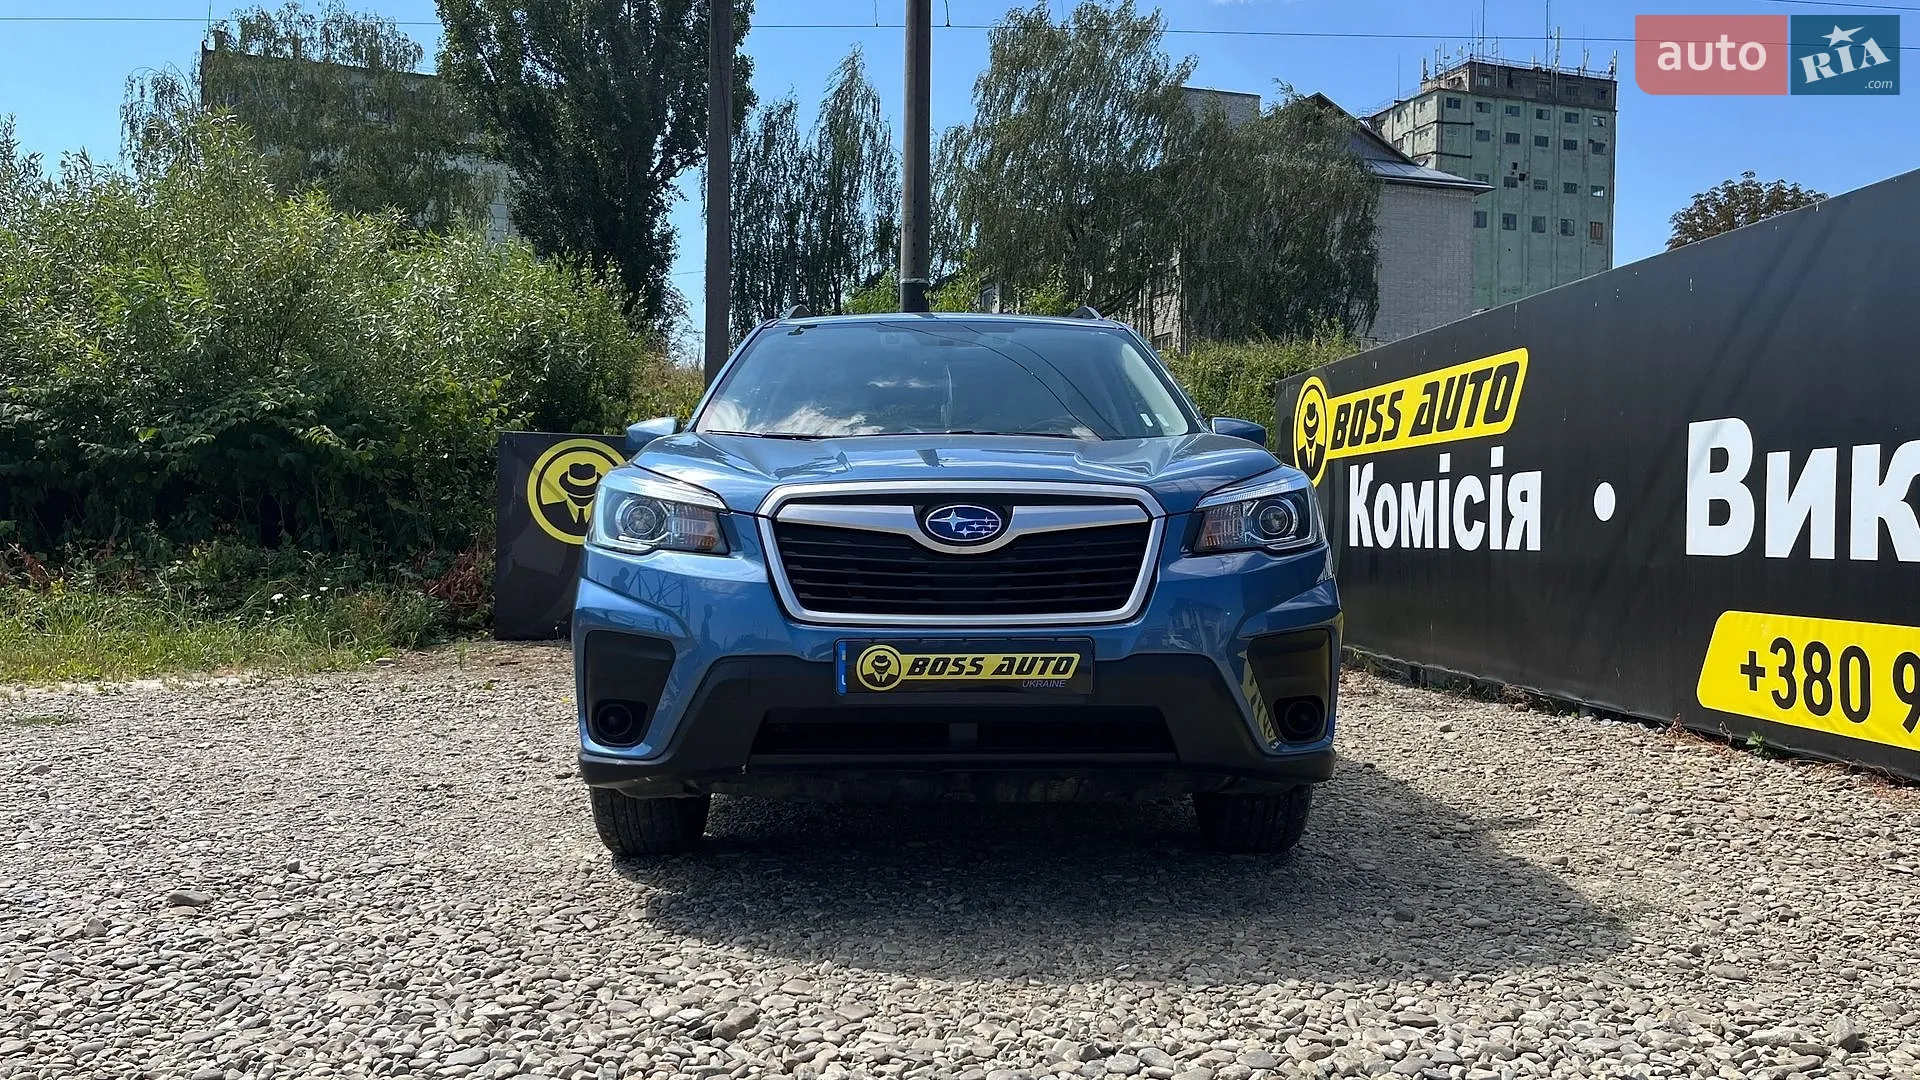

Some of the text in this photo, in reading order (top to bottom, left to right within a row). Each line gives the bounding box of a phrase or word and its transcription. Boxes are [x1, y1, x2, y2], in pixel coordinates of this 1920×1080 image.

[1330, 361, 1520, 450] BOSS AUTO
[1349, 446, 1542, 551] Комісія
[906, 656, 1075, 676] BOSS AUTO
[1022, 679, 1066, 688] UKRAINE
[1740, 637, 1871, 724] +380
